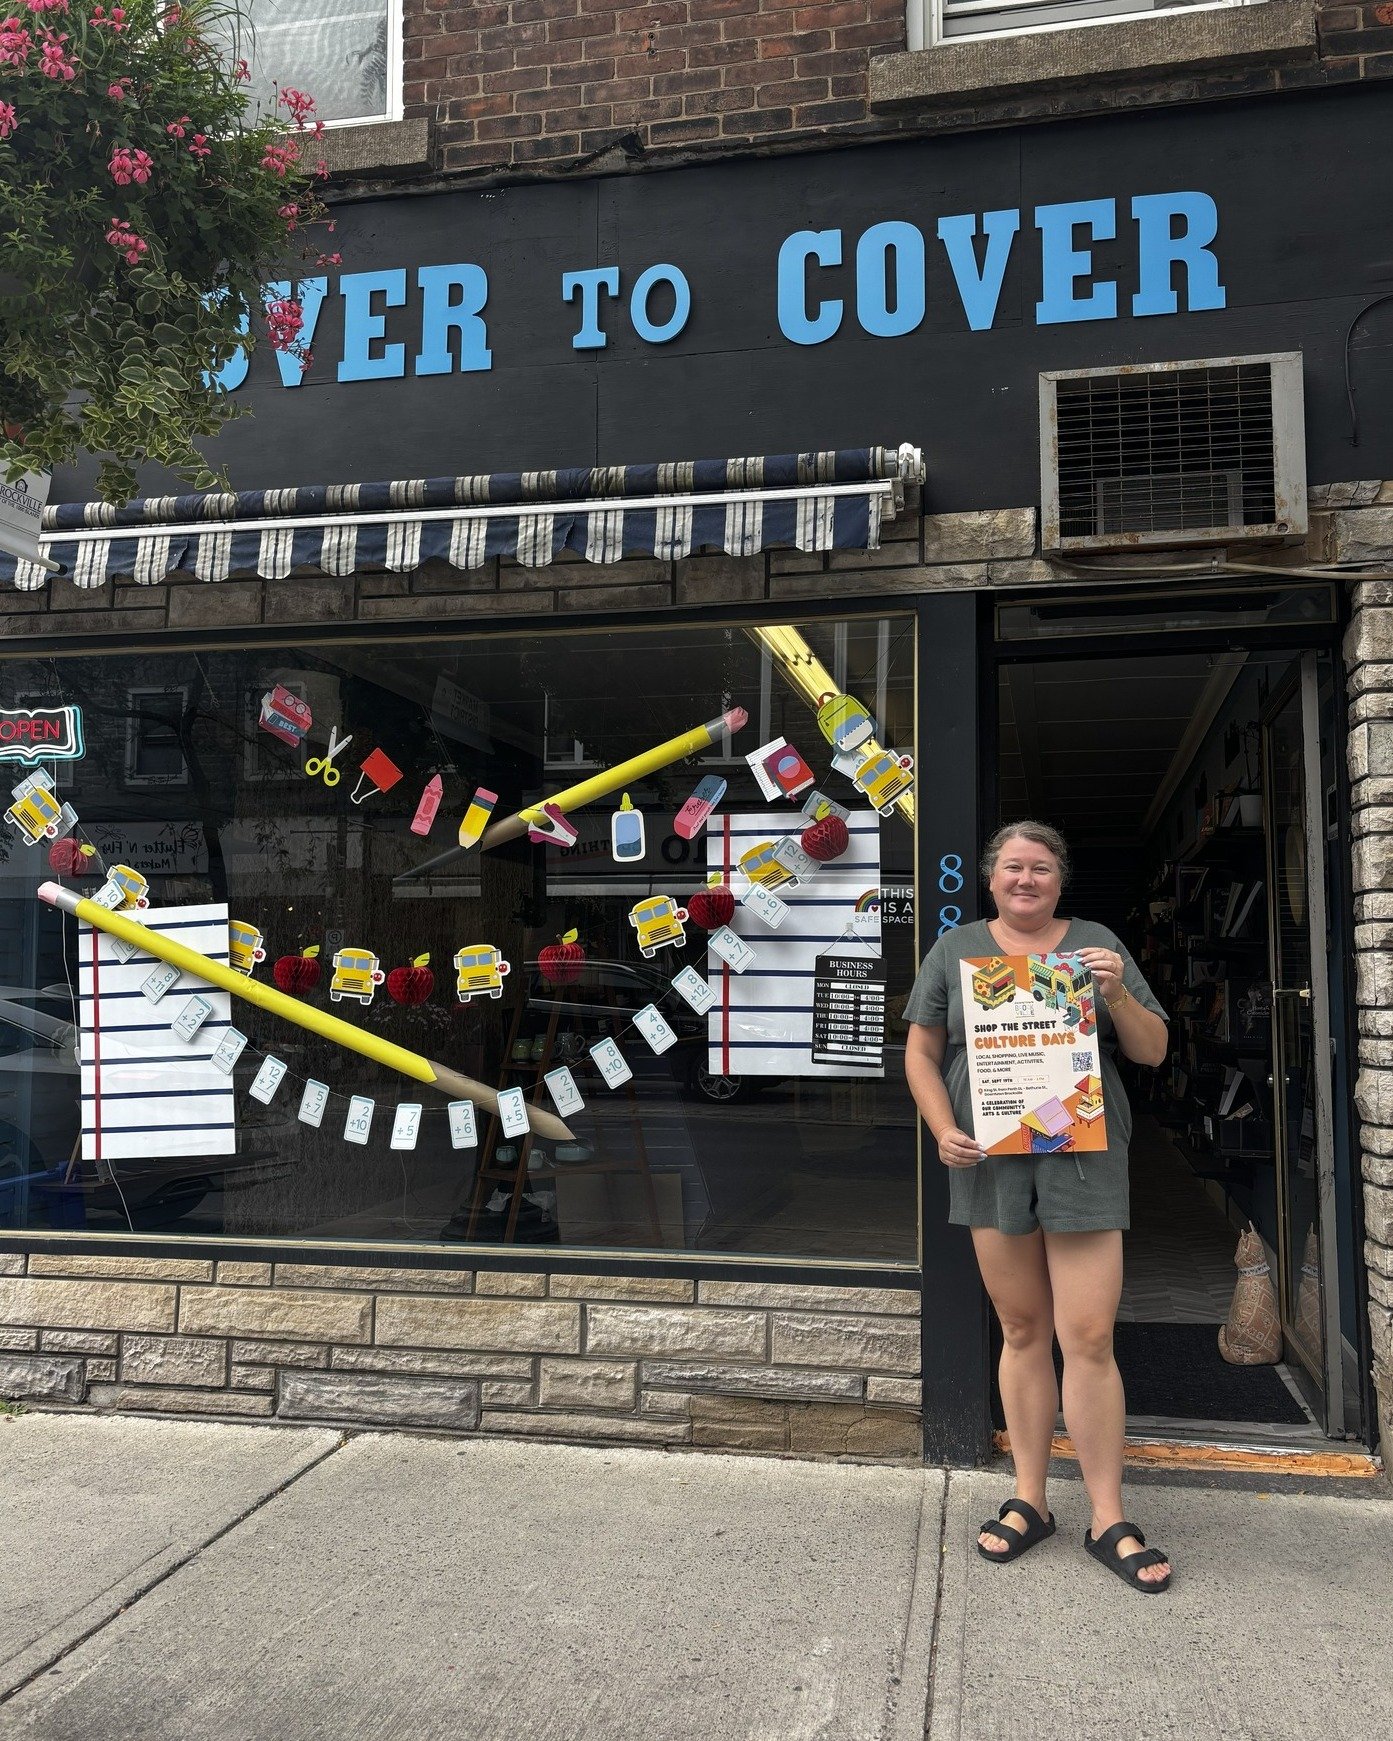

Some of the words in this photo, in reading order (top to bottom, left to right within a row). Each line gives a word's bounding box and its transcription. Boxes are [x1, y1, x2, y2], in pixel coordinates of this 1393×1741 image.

[200, 263, 492, 394] OVER
[562, 263, 691, 350] TO
[777, 191, 1227, 345] COVER
[0, 485, 42, 512] ROCKVILLE
[0, 719, 60, 742] OPEN
[278, 720, 297, 732] BEST
[880, 888, 914, 899] THIS
[883, 902, 897, 913] IS
[902, 902, 914, 913] A
[830, 960, 874, 970] BUSINESS
[836, 969, 868, 978] HOURS
[974, 1024, 998, 1033] SHOP
[1001, 1023, 1019, 1031] THE
[1022, 1020, 1056, 1030] STREET
[974, 1034, 1036, 1049] CULTURE
[1041, 1032, 1076, 1046] DAYS
